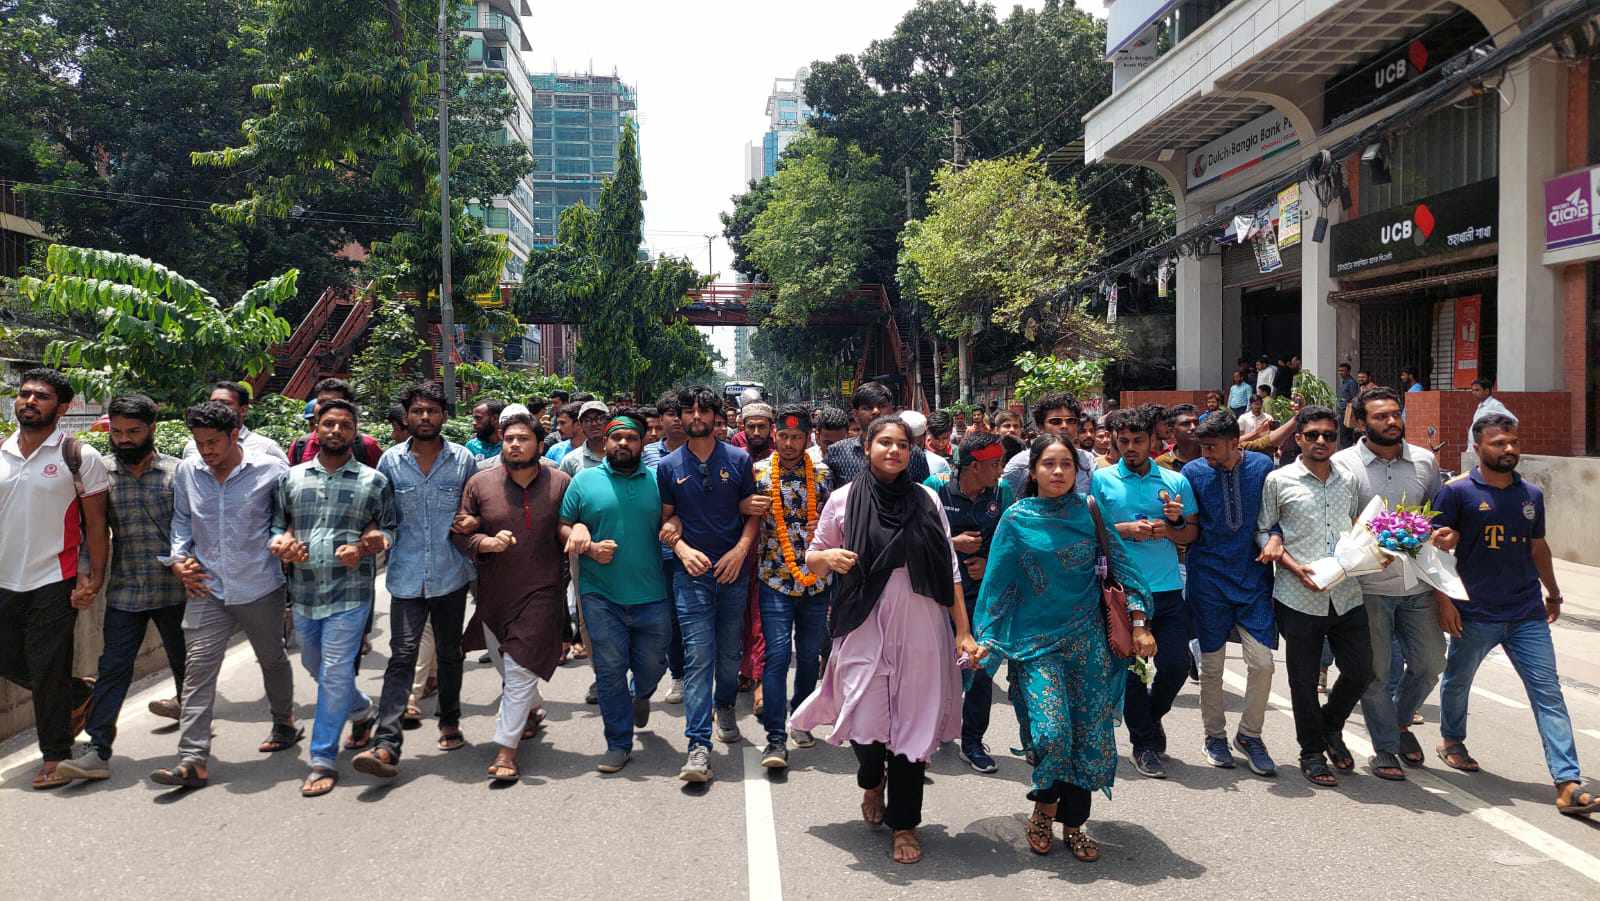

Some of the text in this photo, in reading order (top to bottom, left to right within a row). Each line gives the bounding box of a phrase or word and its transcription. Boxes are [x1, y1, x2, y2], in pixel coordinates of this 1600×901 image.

[1374, 58, 1407, 89] UCB
[1208, 134, 1259, 168] Dutch-Bangla
[1260, 120, 1281, 142] Bank
[1381, 219, 1413, 245] UCB
[1484, 524, 1505, 549] T
